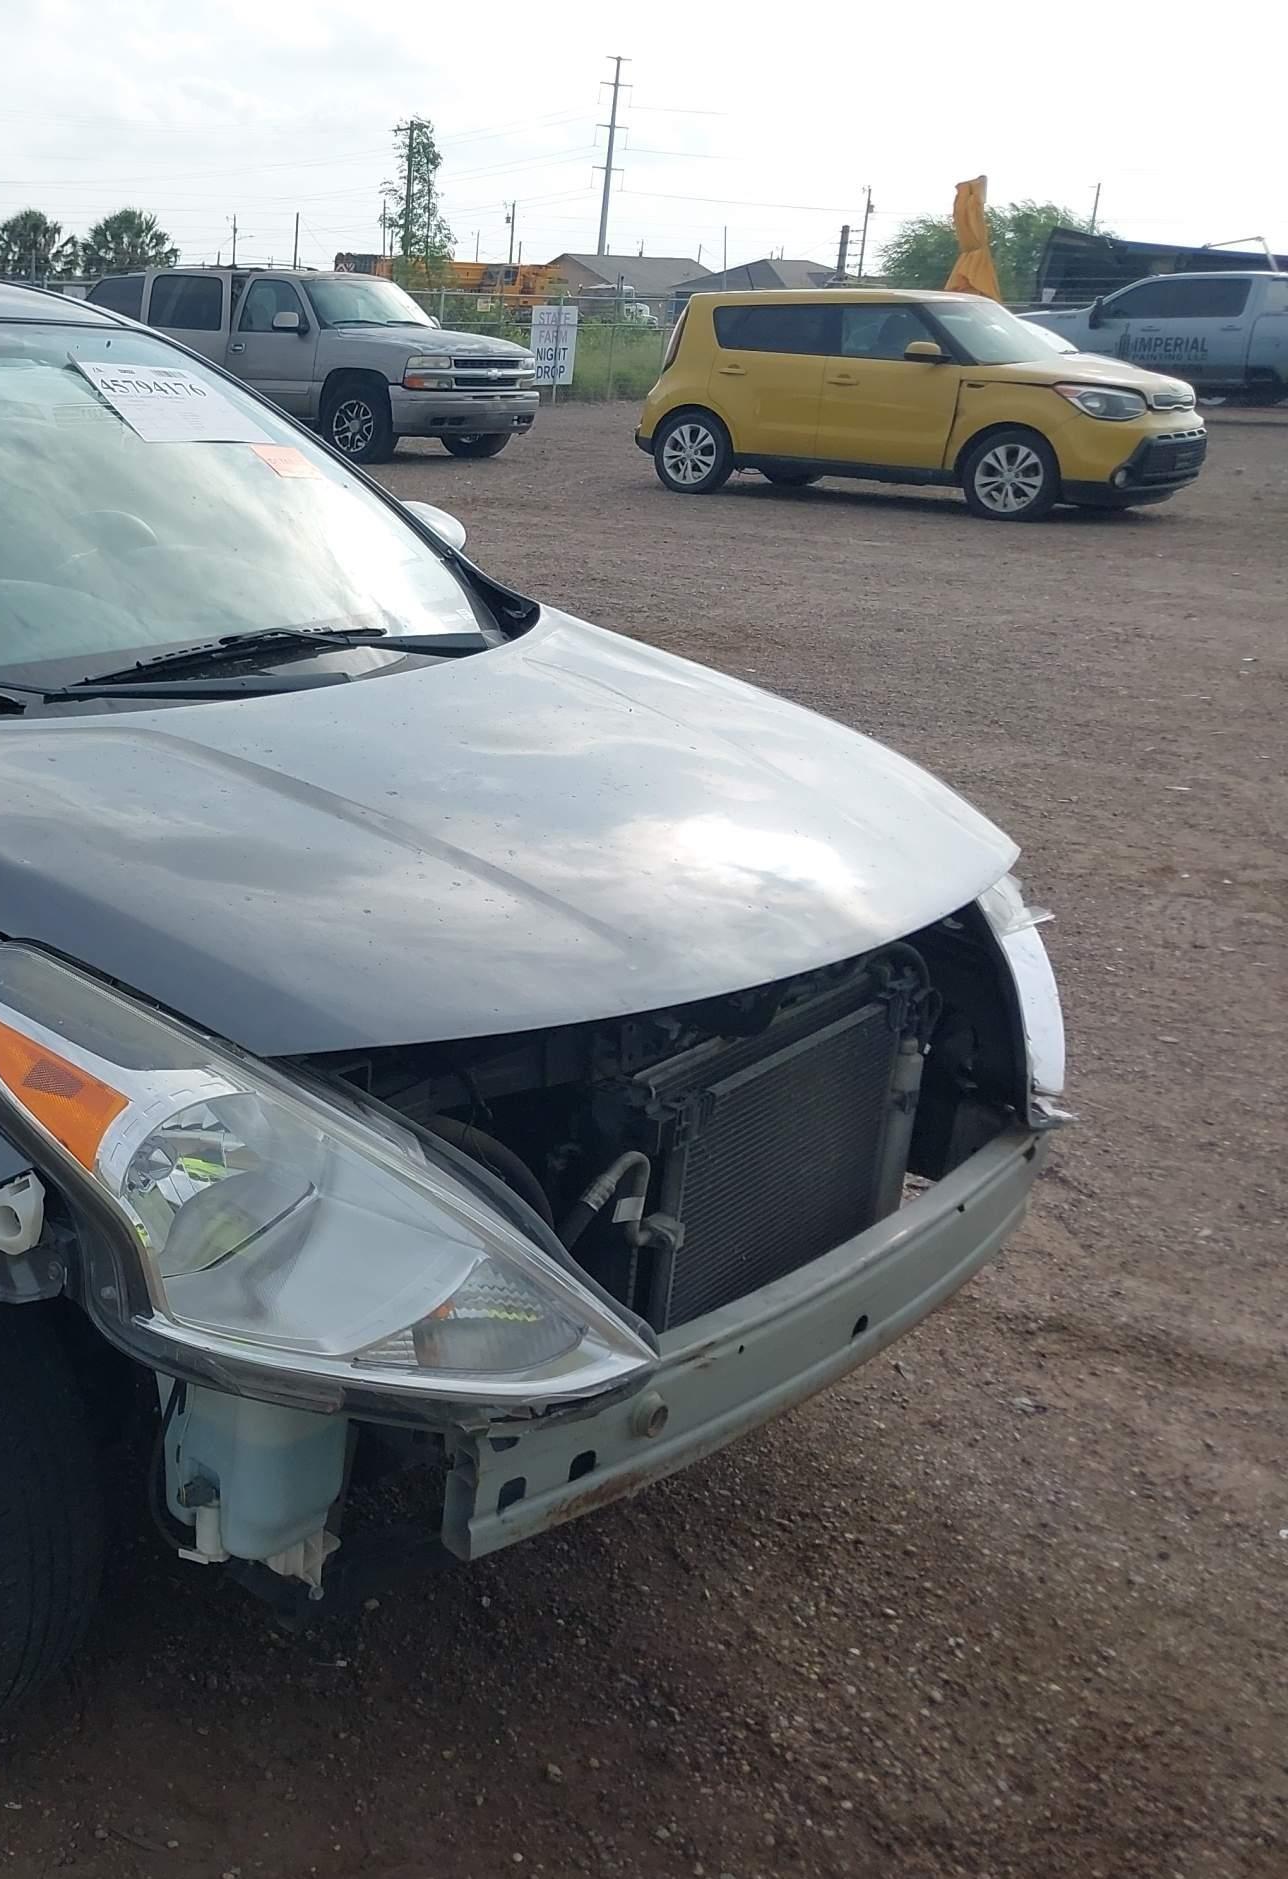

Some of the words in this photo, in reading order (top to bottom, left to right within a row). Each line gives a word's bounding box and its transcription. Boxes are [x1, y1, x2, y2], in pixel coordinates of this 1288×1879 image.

[1134, 336, 1208, 353] IMPERIAL
[536, 365, 565, 379] DROP
[100, 378, 207, 398] 45794176
